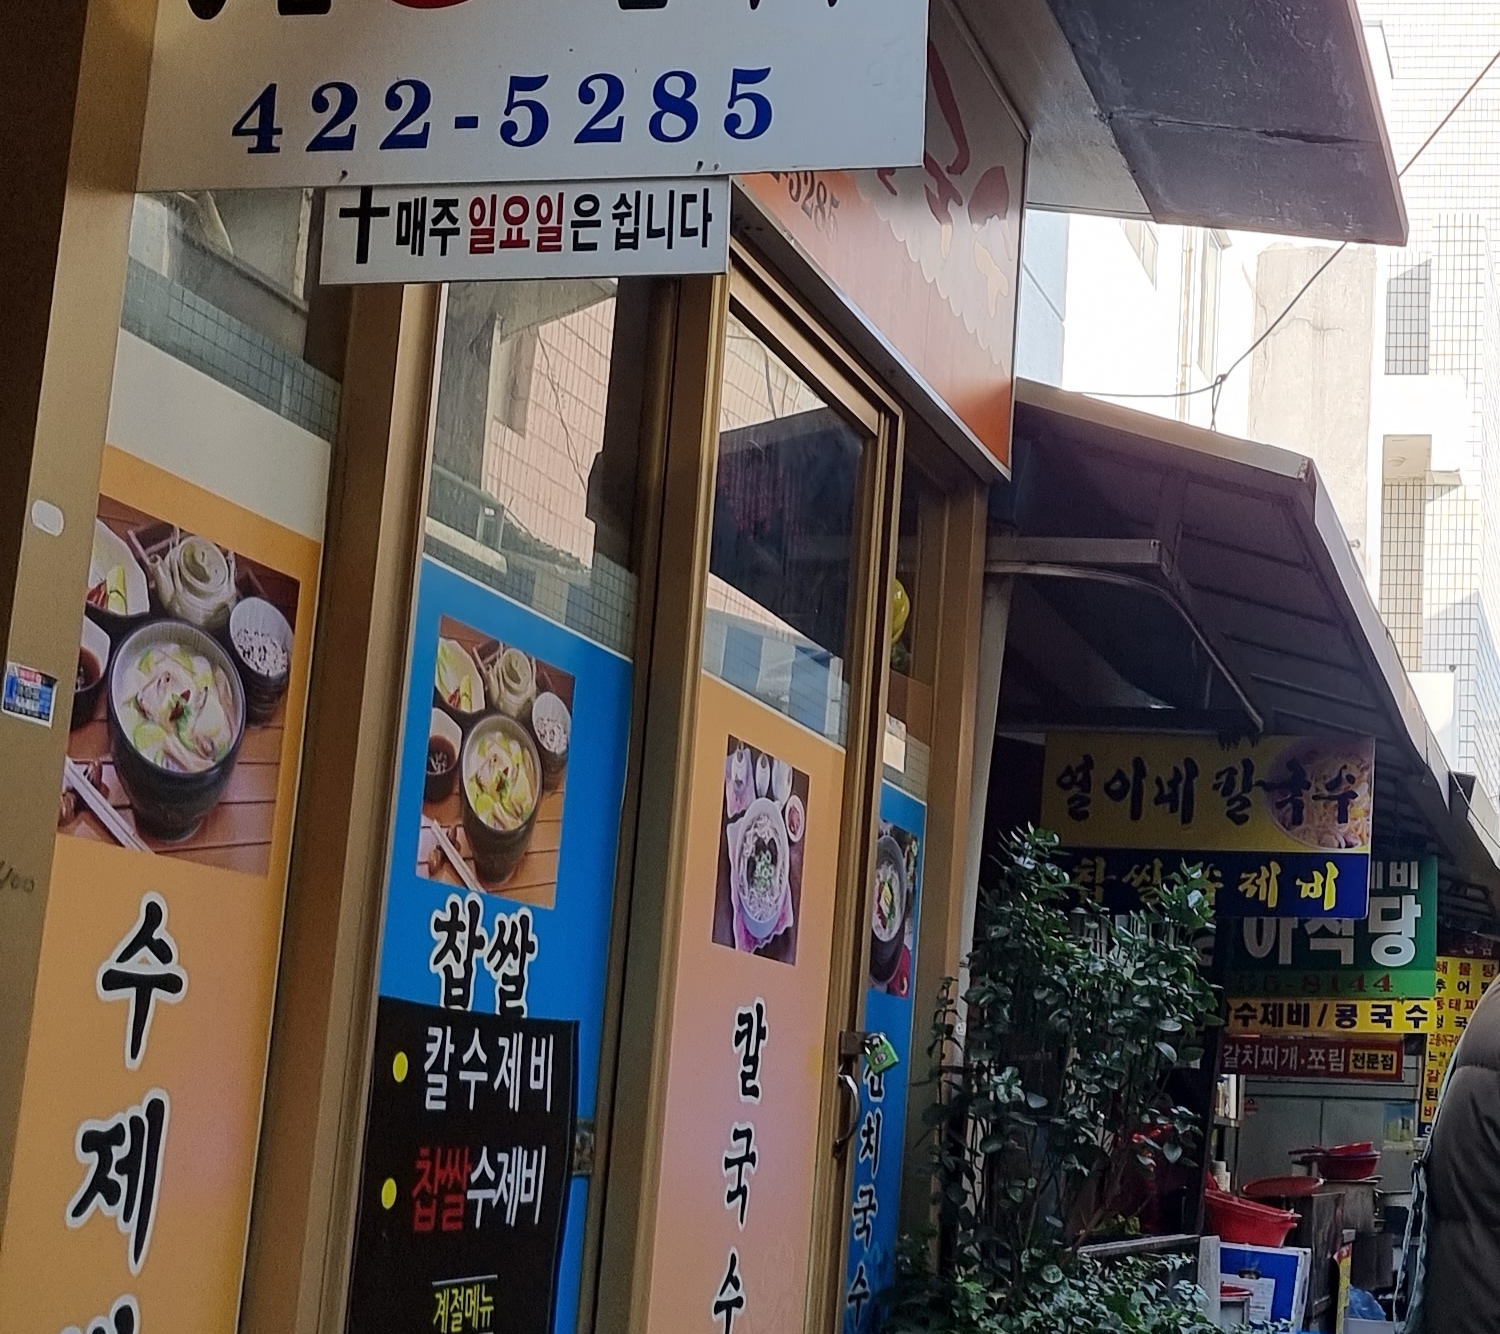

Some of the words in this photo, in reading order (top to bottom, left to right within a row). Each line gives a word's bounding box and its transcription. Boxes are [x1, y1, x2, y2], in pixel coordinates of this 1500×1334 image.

[232, 67, 774, 155] 422-5285
[395, 196, 461, 257] 매주
[468, 192, 602, 255] 일요일은
[612, 188, 713, 251] 쉽니다
[1212, 758, 1360, 827] 칼국수
[430, 895, 537, 1018] 찹쌀
[1224, 1002, 1429, 1029] 수제비/콩국수
[424, 1025, 554, 1113] 칼수제비
[1351, 1051, 1394, 1071] 전문점
[412, 1146, 547, 1232] 찹쌀수제비
[432, 1283, 495, 1334] 계절메뉴
